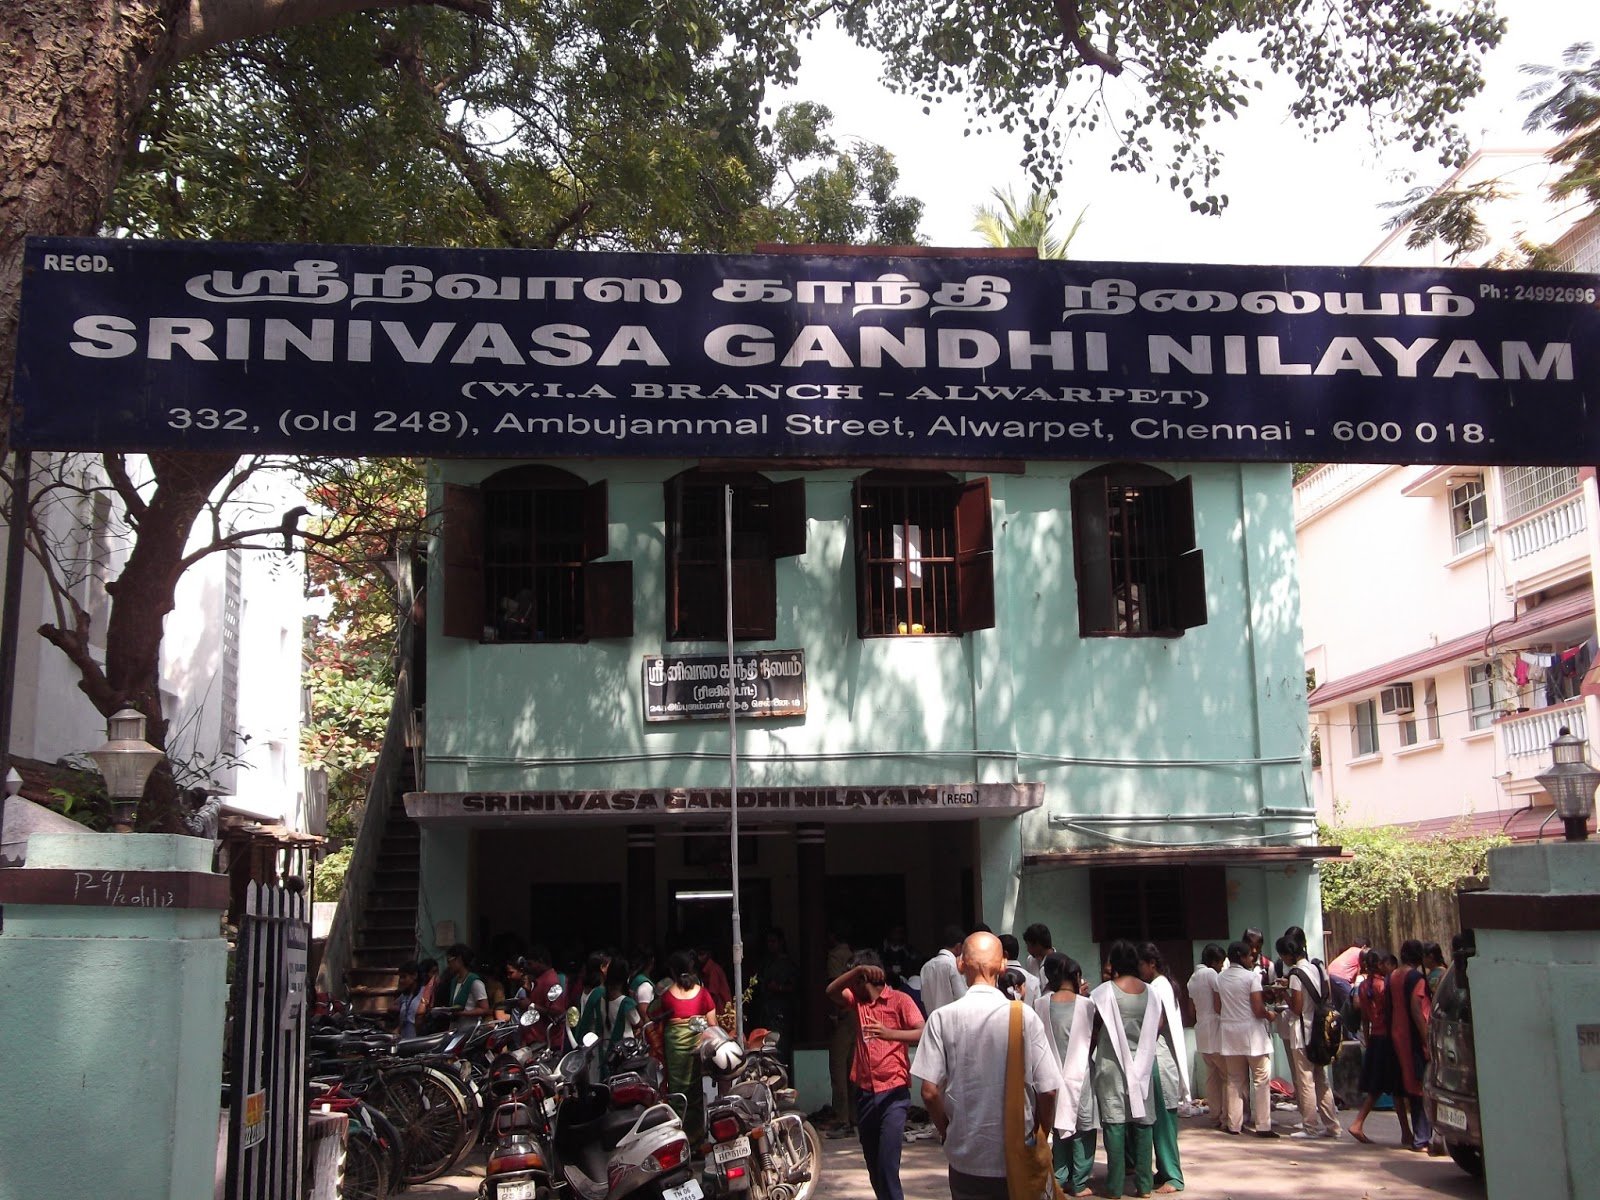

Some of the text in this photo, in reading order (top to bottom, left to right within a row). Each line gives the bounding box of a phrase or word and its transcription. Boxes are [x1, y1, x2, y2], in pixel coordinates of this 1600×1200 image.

[45, 255, 113, 272] REGD.
[712, 273, 1011, 318] காந்தி
[1063, 275, 1474, 322] நிலையம்
[1515, 286, 1596, 304] 24992696
[70, 315, 1573, 379] SRINIVASA GANDHI NILAYAM
[462, 382, 616, 399] (W.I.A
[631, 384, 863, 399] BRANCH
[906, 386, 1208, 408] ALWARPET)
[168, 408, 259, 433] 332,
[279, 410, 355, 435] (old
[374, 411, 478, 435] 248),
[494, 413, 767, 439] Ambujammal
[786, 414, 914, 438] Street,
[928, 416, 1113, 441] Alwarpet,
[1131, 418, 1290, 440] Chennai
[1333, 421, 1401, 442] 600
[463, 793, 657, 812] SRINIVASA
[664, 791, 791, 810] GANDHI
[794, 788, 937, 808] NILAYAM
